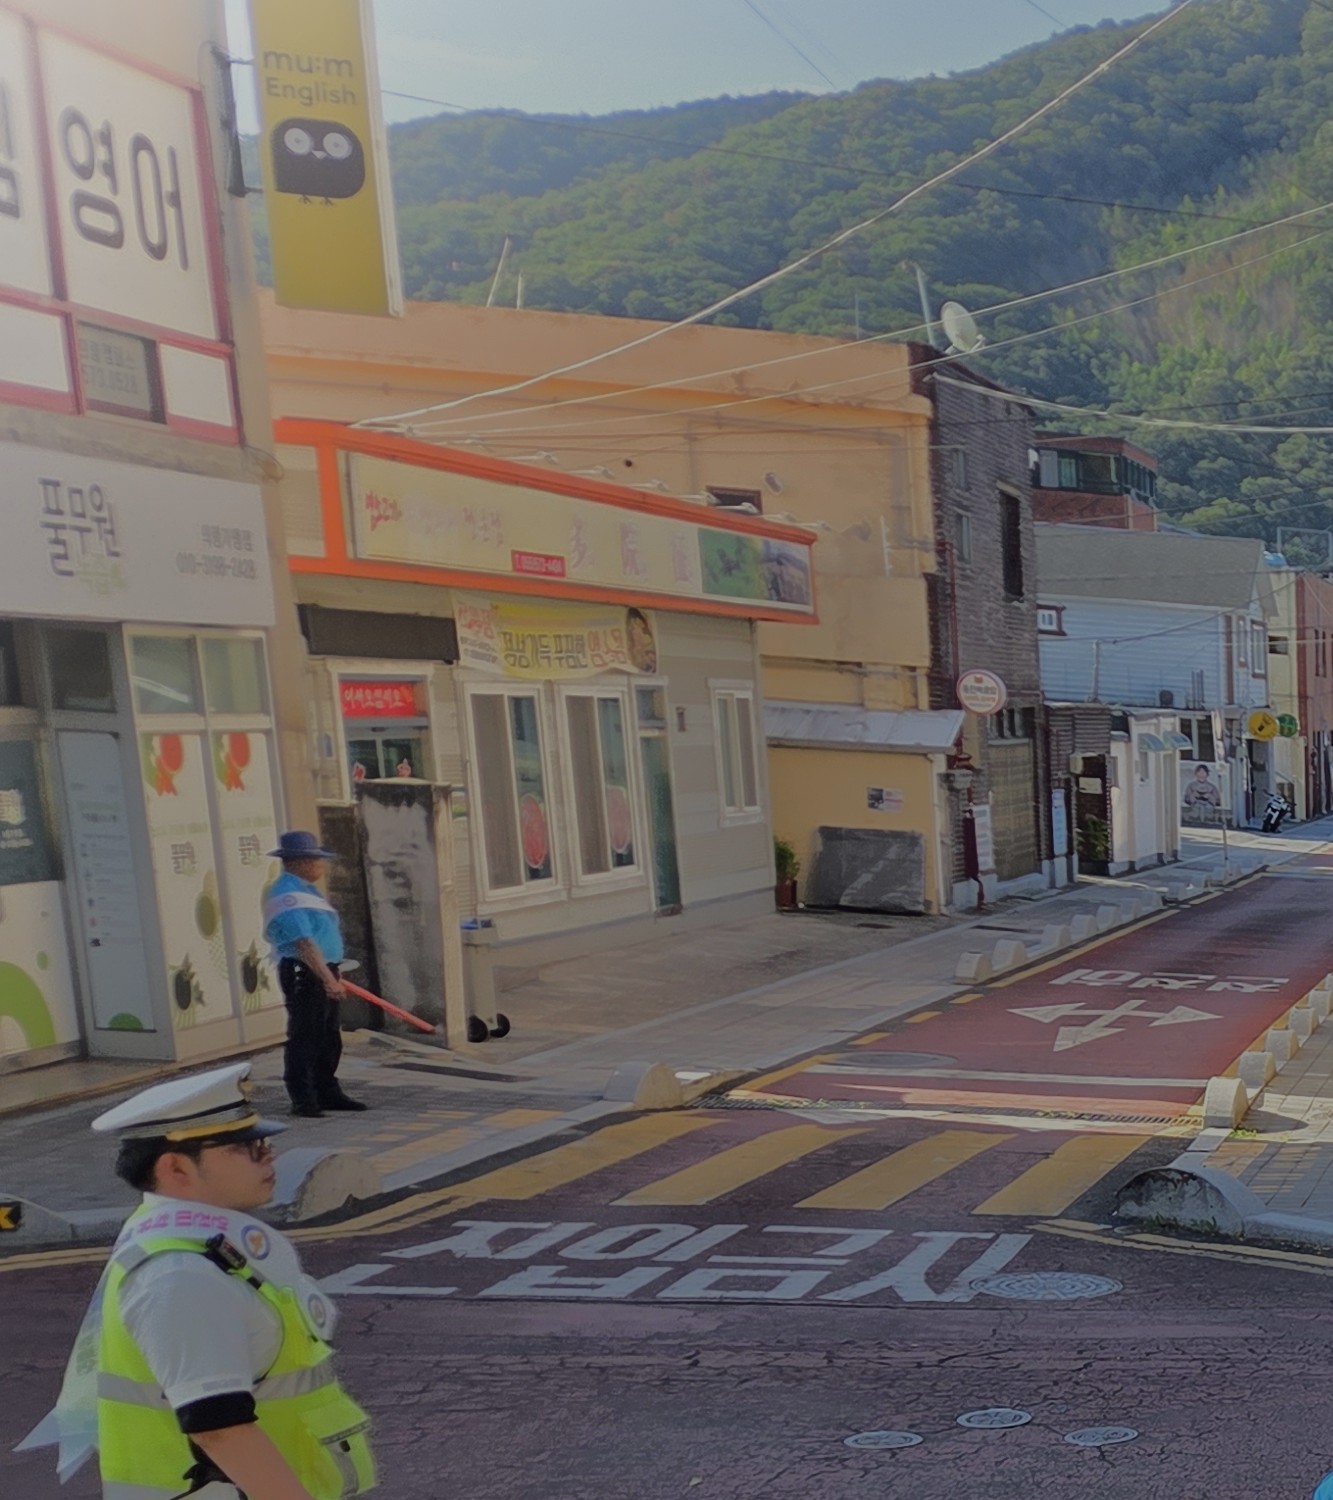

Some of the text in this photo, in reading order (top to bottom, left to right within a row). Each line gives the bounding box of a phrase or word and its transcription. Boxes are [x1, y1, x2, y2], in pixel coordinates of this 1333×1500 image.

[263, 50, 354, 78] mu:m
[265, 77, 357, 106] English
[58, 105, 190, 272] 영어
[38, 477, 121, 577] 풀무원
[1048, 968, 1290, 993] 천천히
[316, 1218, 1032, 1304] 진입금지
